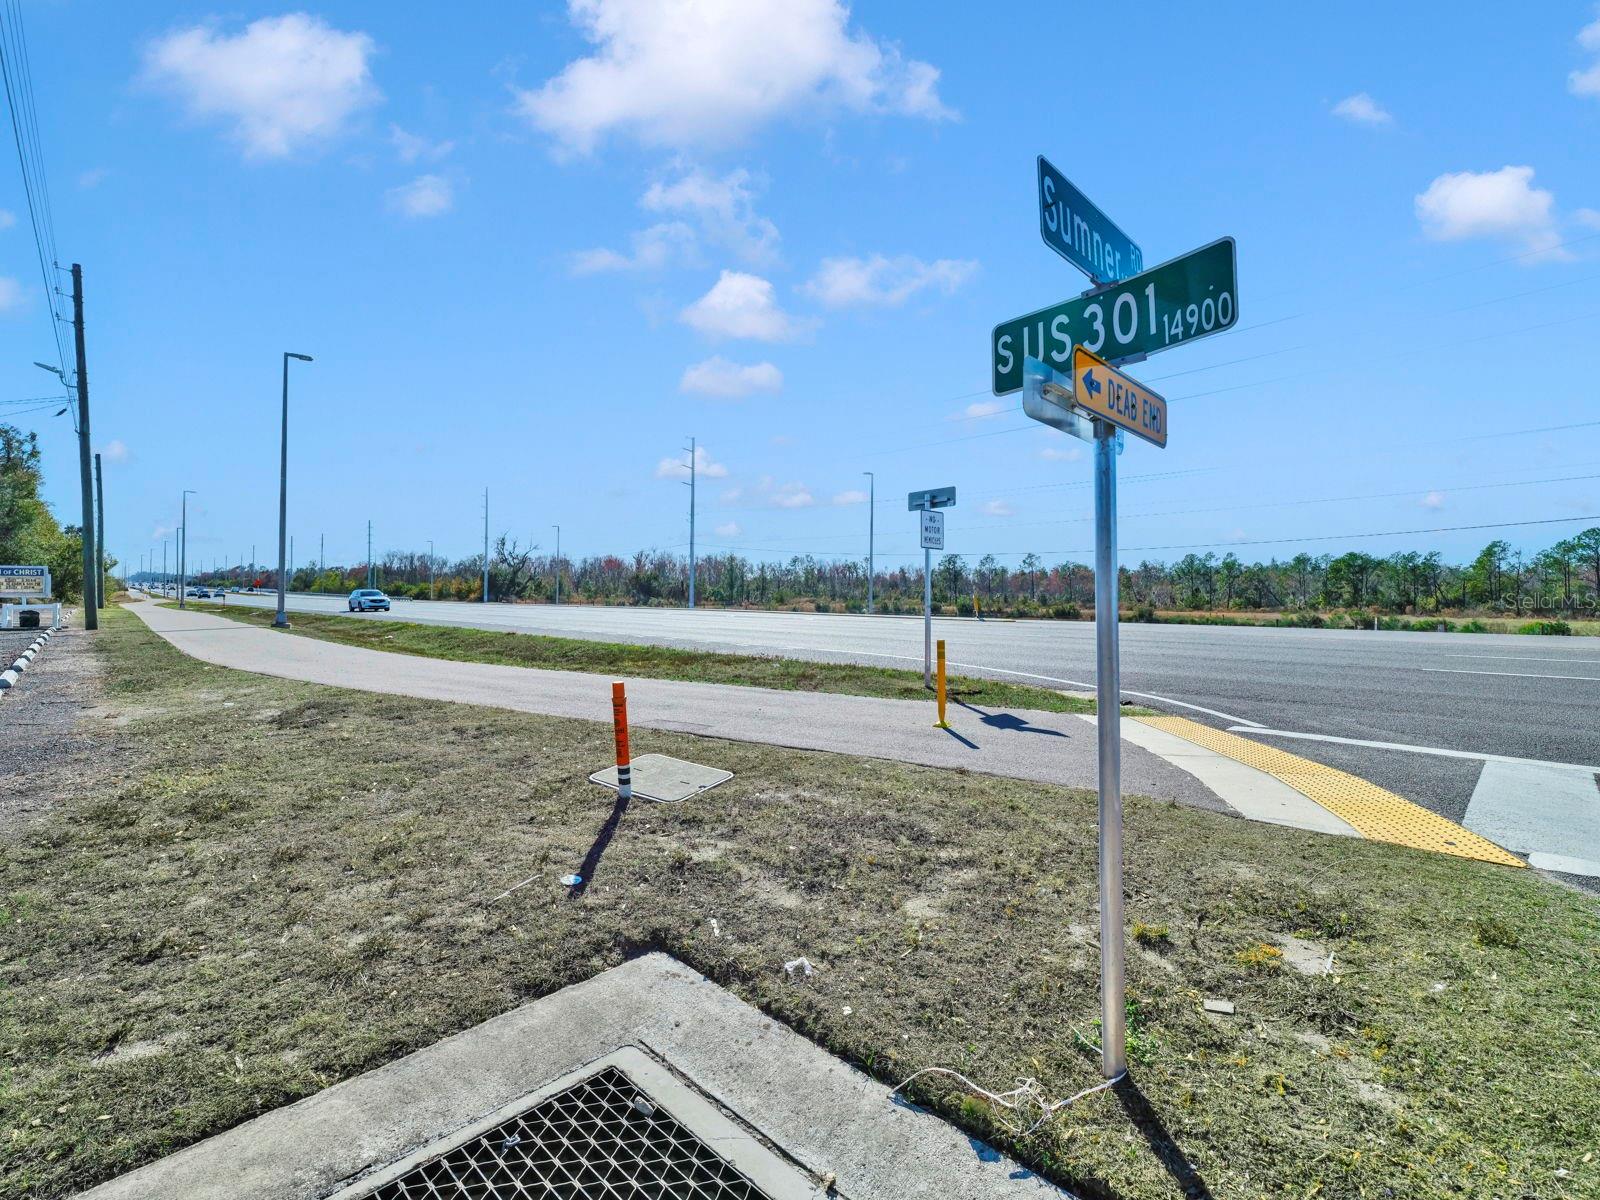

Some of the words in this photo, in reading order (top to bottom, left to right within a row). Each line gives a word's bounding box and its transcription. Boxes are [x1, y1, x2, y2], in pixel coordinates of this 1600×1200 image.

[1043, 175, 1121, 280] Sumner
[1130, 243, 1142, 274] RD
[997, 334, 1014, 374] S
[1023, 314, 1072, 363] US
[1082, 283, 1157, 353] 301
[1163, 291, 1232, 345] 14900
[1108, 378, 1138, 422] DEAD
[1143, 399, 1162, 434] END
[924, 525, 941, 535] MOTOR
[929, 515, 937, 524] NO
[13, 568, 42, 576] CHRIST
